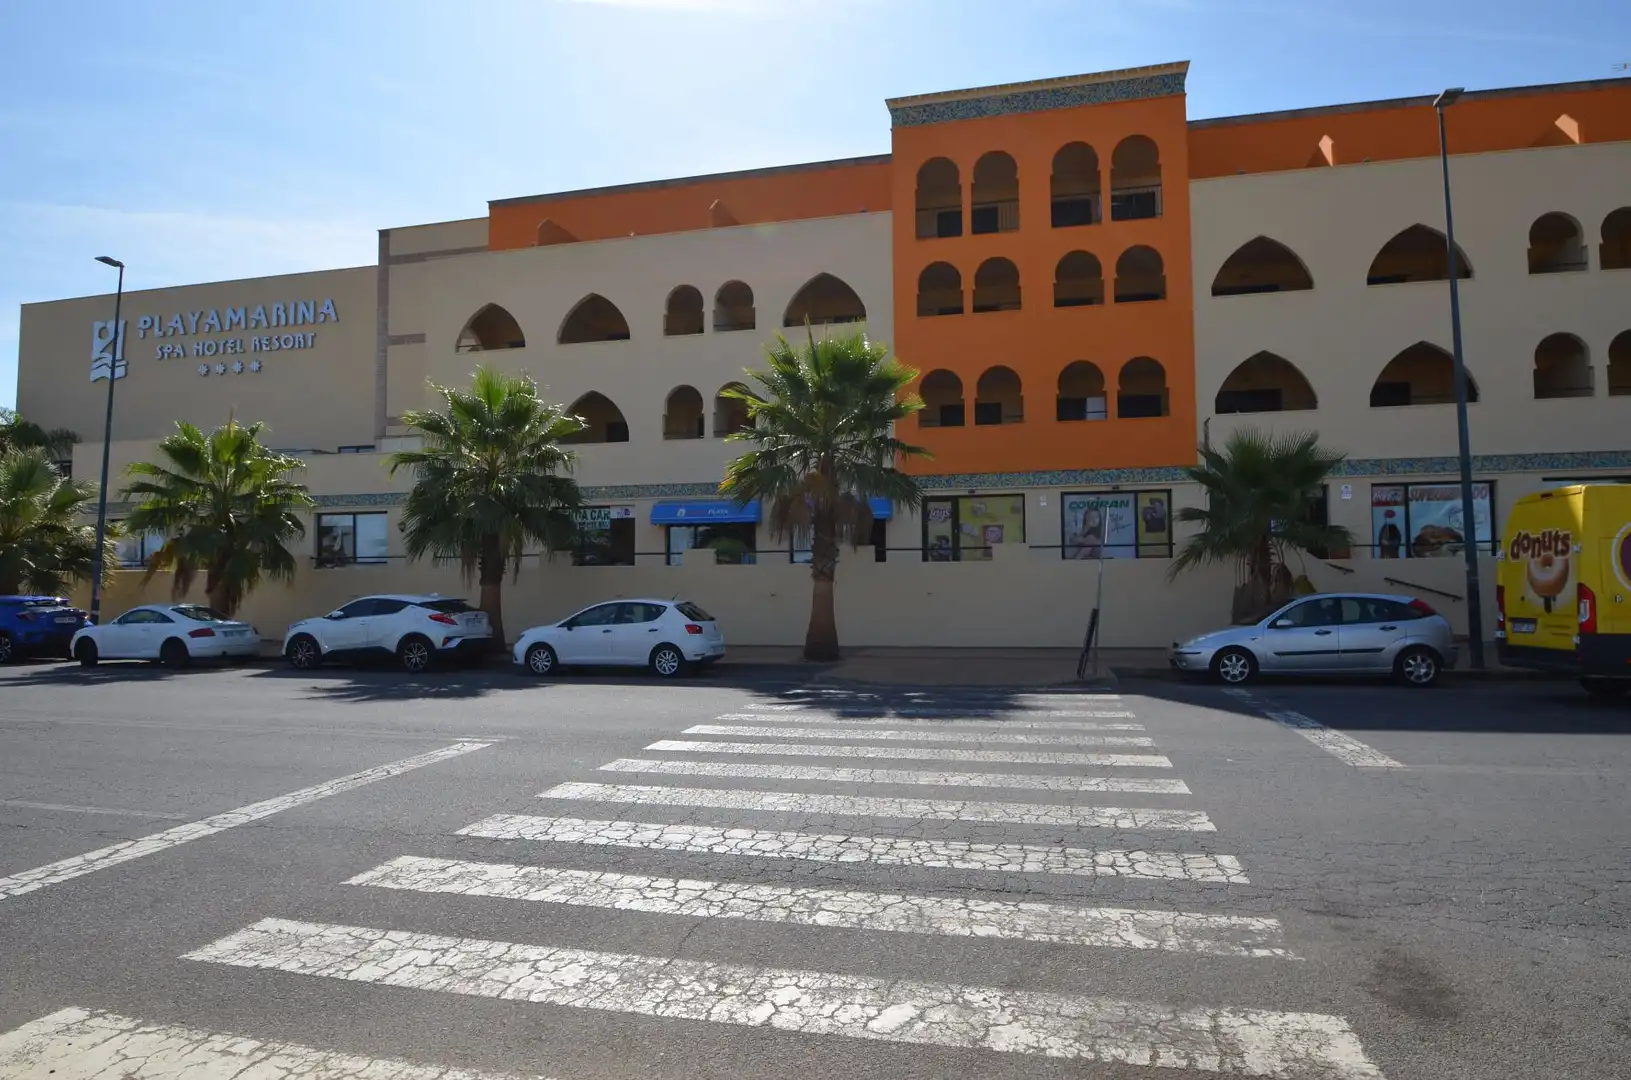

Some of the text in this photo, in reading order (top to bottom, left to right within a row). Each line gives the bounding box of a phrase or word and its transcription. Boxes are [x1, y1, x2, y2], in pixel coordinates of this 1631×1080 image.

[137, 297, 339, 339] PLAYAMARINA
[155, 332, 317, 361] SPA HOTEL RESORT
[590, 509, 610, 520] CAR
[1510, 529, 1571, 561] donuts
